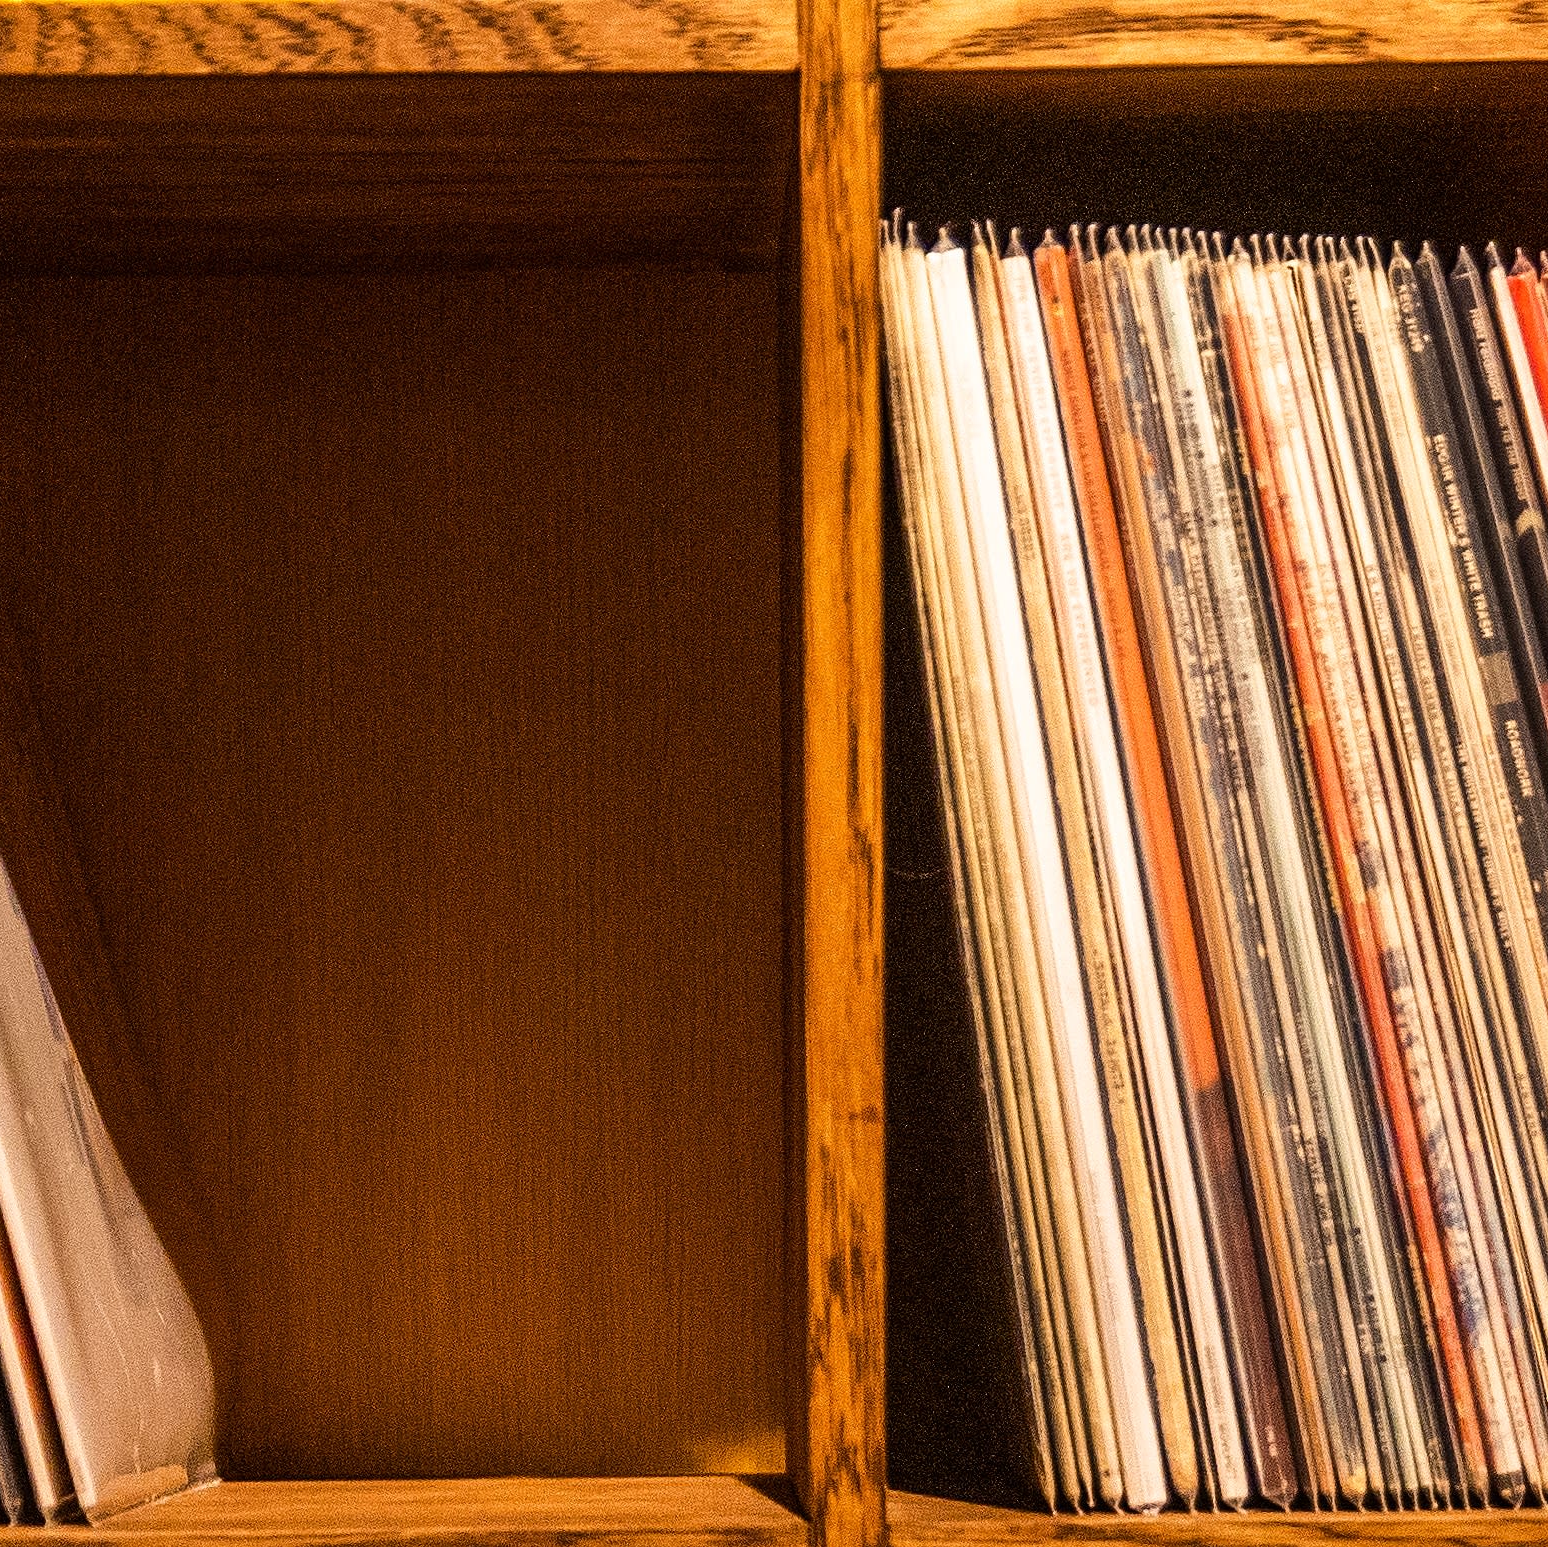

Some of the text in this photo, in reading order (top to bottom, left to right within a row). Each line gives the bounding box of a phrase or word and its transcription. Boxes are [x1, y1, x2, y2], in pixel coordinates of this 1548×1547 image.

[1460, 548, 1483, 592] WHITE
[1471, 593, 1495, 639] TRASH
[1502, 718, 1534, 797] ROADWORK
